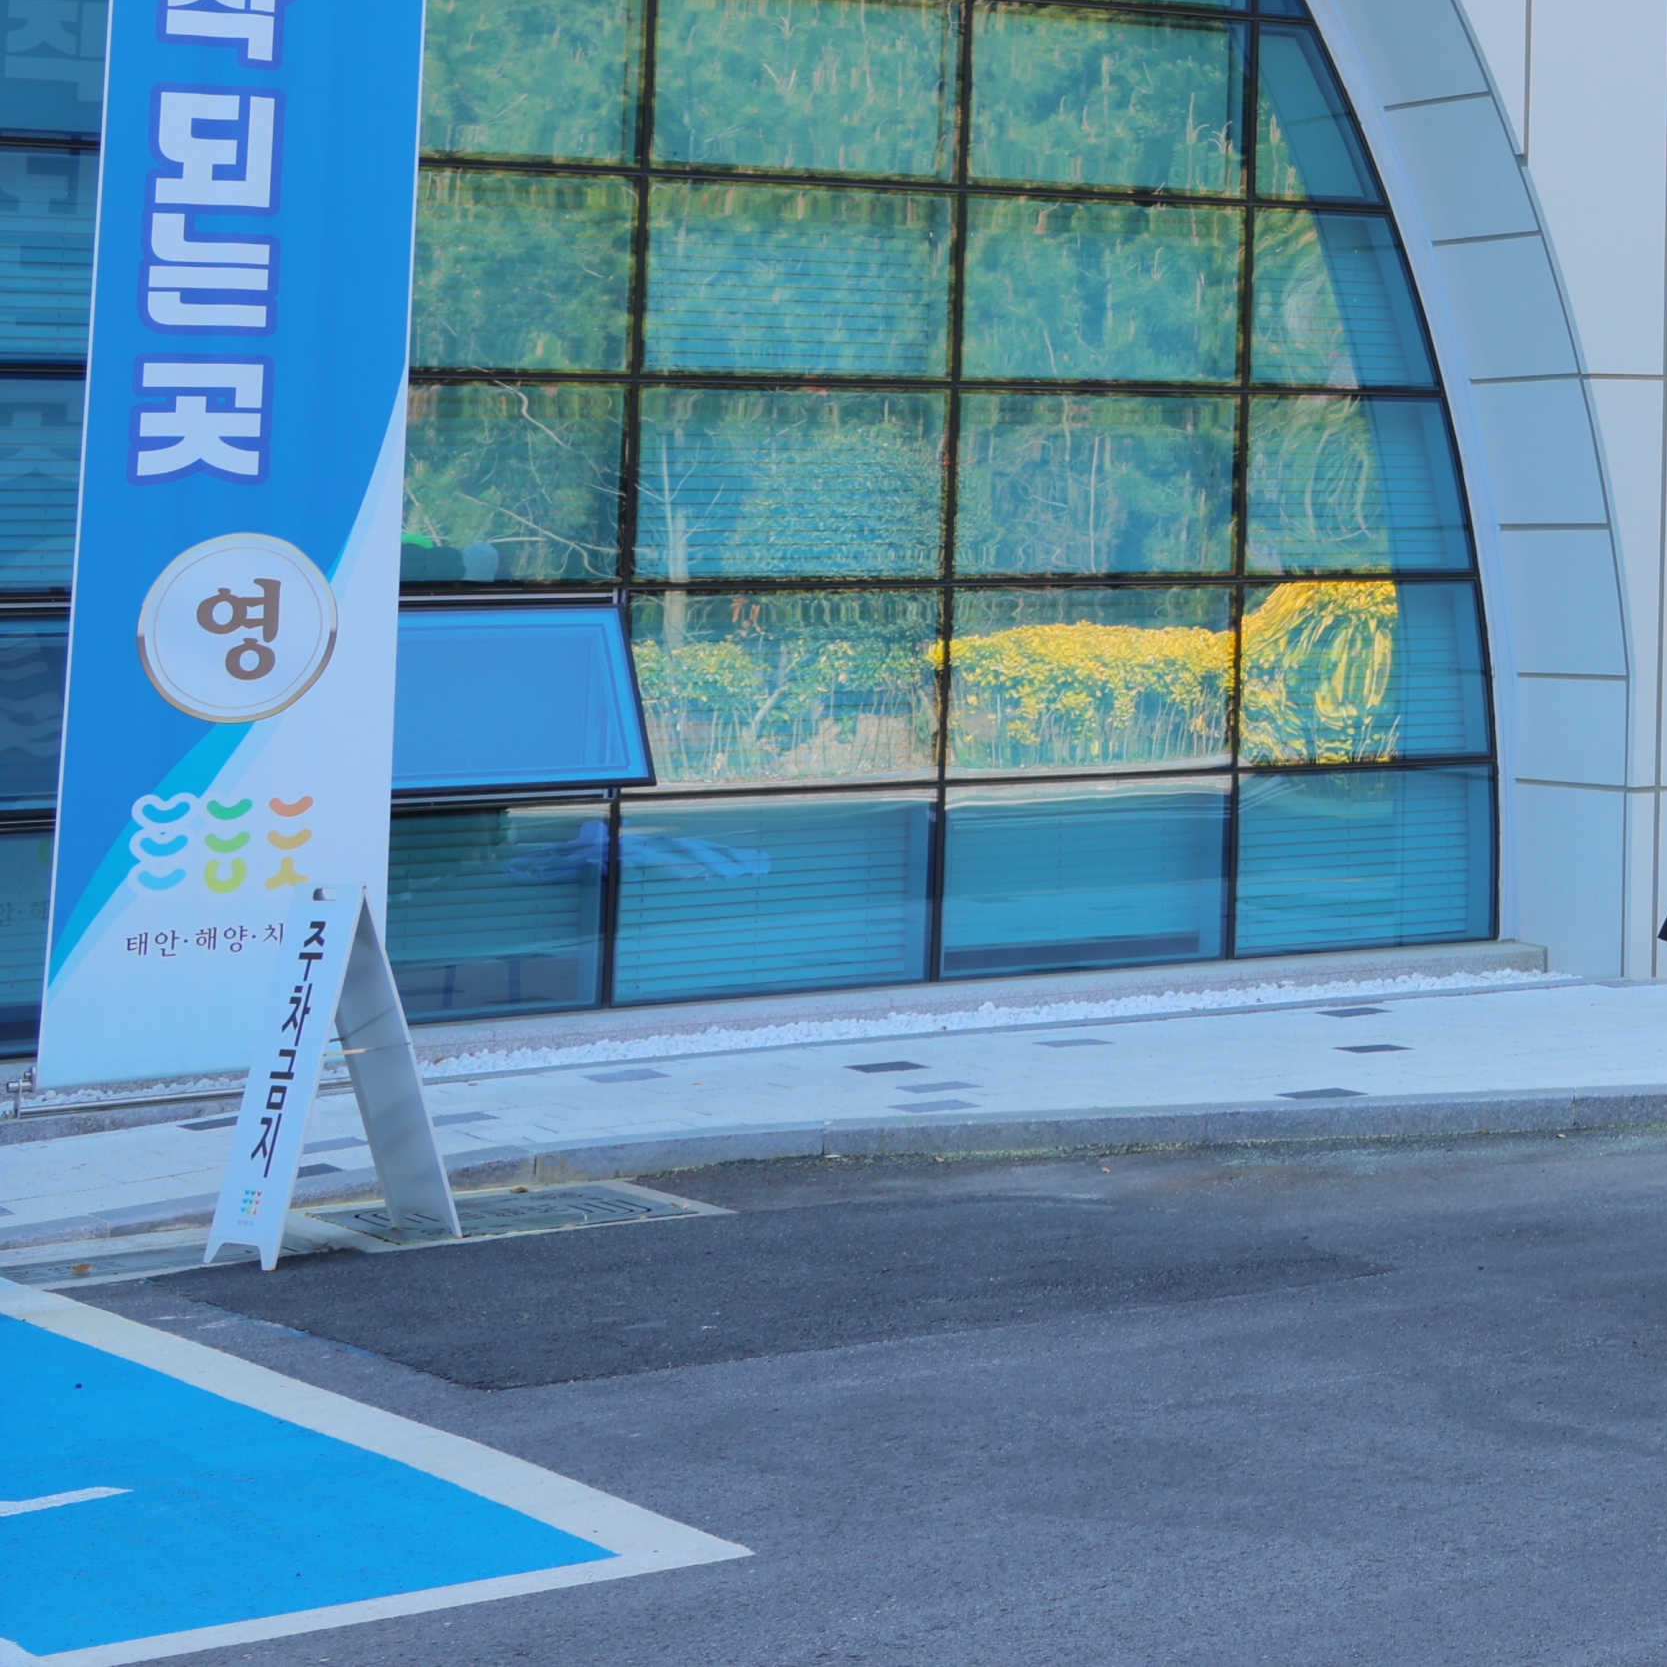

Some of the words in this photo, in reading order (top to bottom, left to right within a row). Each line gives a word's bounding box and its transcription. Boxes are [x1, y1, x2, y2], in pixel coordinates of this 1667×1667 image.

[147, 91, 276, 328] 되는
[137, 363, 265, 476] 곳
[197, 577, 282, 681] 영
[126, 923, 285, 957] 태안·해양·치
[250, 920, 327, 1179] 주차금지
